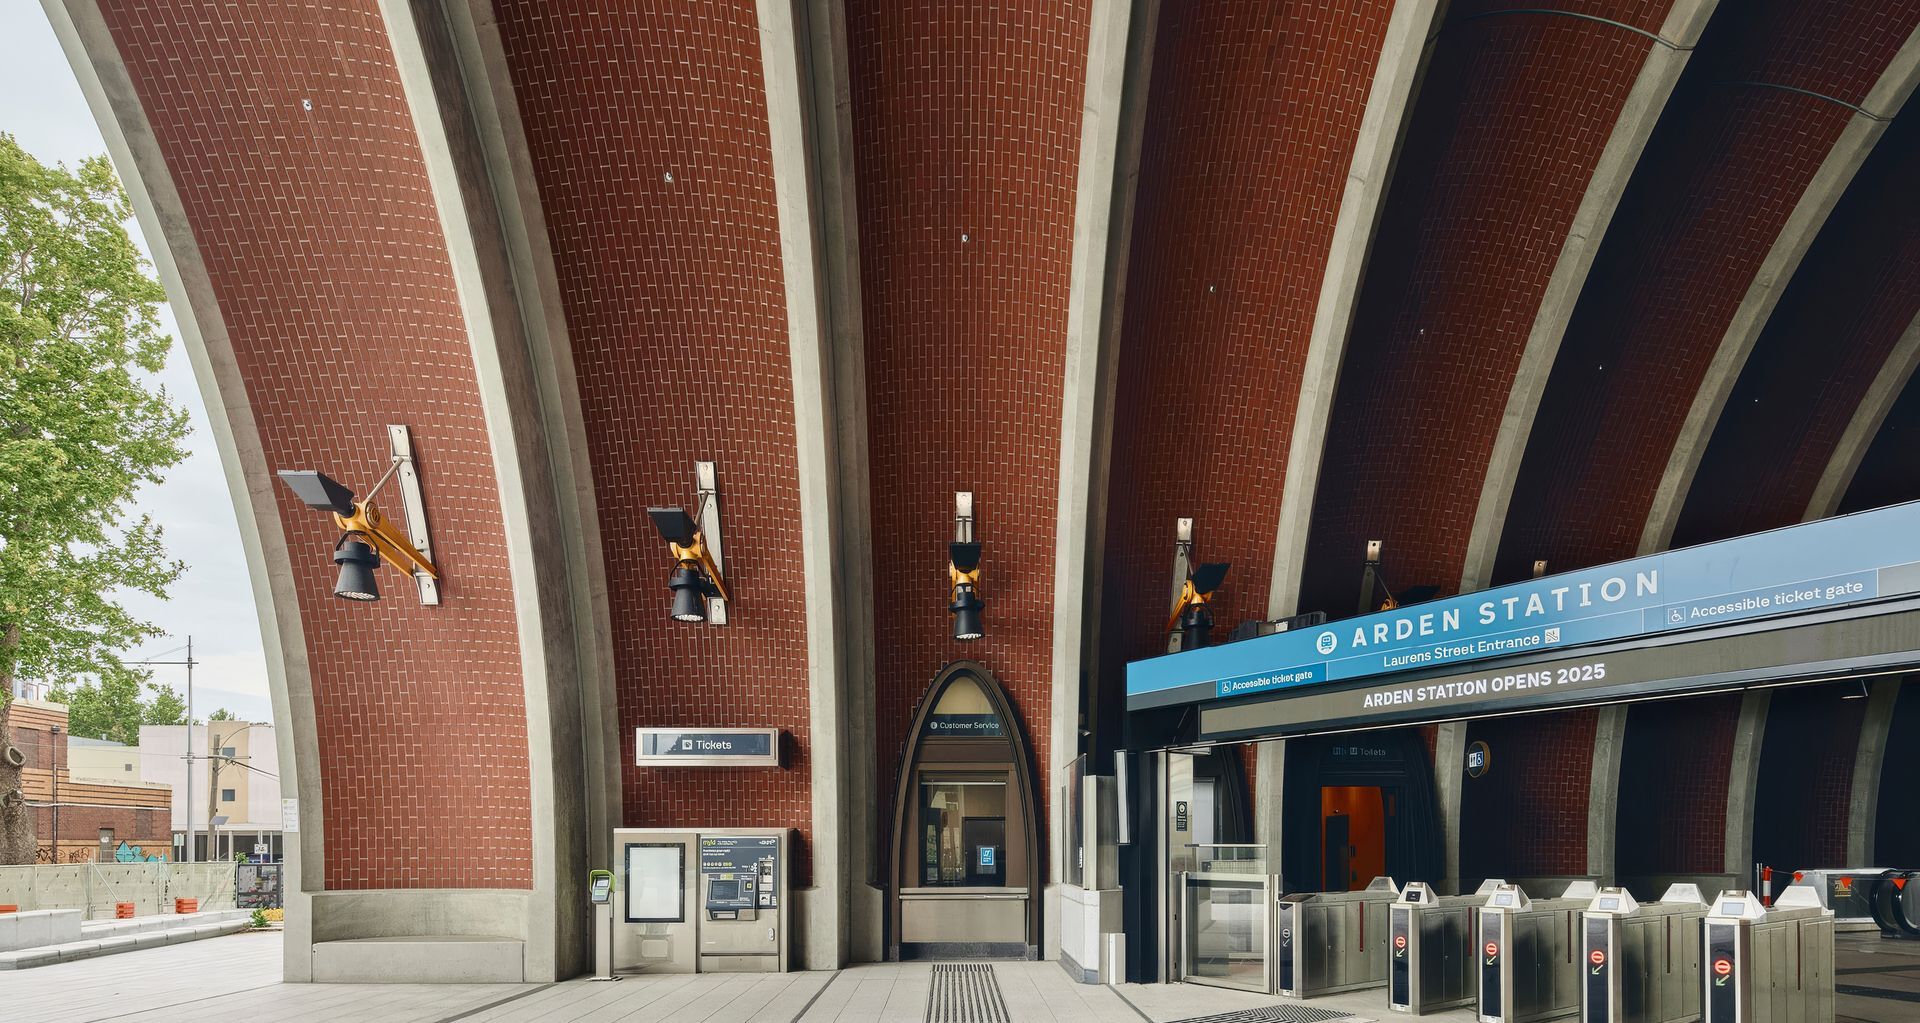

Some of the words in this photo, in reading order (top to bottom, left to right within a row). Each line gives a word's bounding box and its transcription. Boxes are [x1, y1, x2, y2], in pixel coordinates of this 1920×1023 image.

[1352, 608, 1460, 647] ARDEN
[1479, 570, 1658, 625] STATION
[1690, 597, 1770, 619] Accessible
[1774, 586, 1821, 605] ticket
[1825, 582, 1864, 600] gate
[1383, 650, 1432, 667] Laurens
[1434, 643, 1475, 660] Street
[1478, 633, 1540, 653] Entrance
[1232, 678, 1271, 690] Accessible
[1272, 673, 1294, 684] ticket
[1295, 671, 1313, 683] gate
[1363, 688, 1413, 708] ARDEN
[1417, 678, 1487, 702] STATION
[1491, 670, 1551, 692] OPENS
[1557, 663, 1606, 685] 2025
[940, 721, 973, 729] Customer
[973, 721, 1000, 729] Service
[696, 740, 732, 750] Tickets
